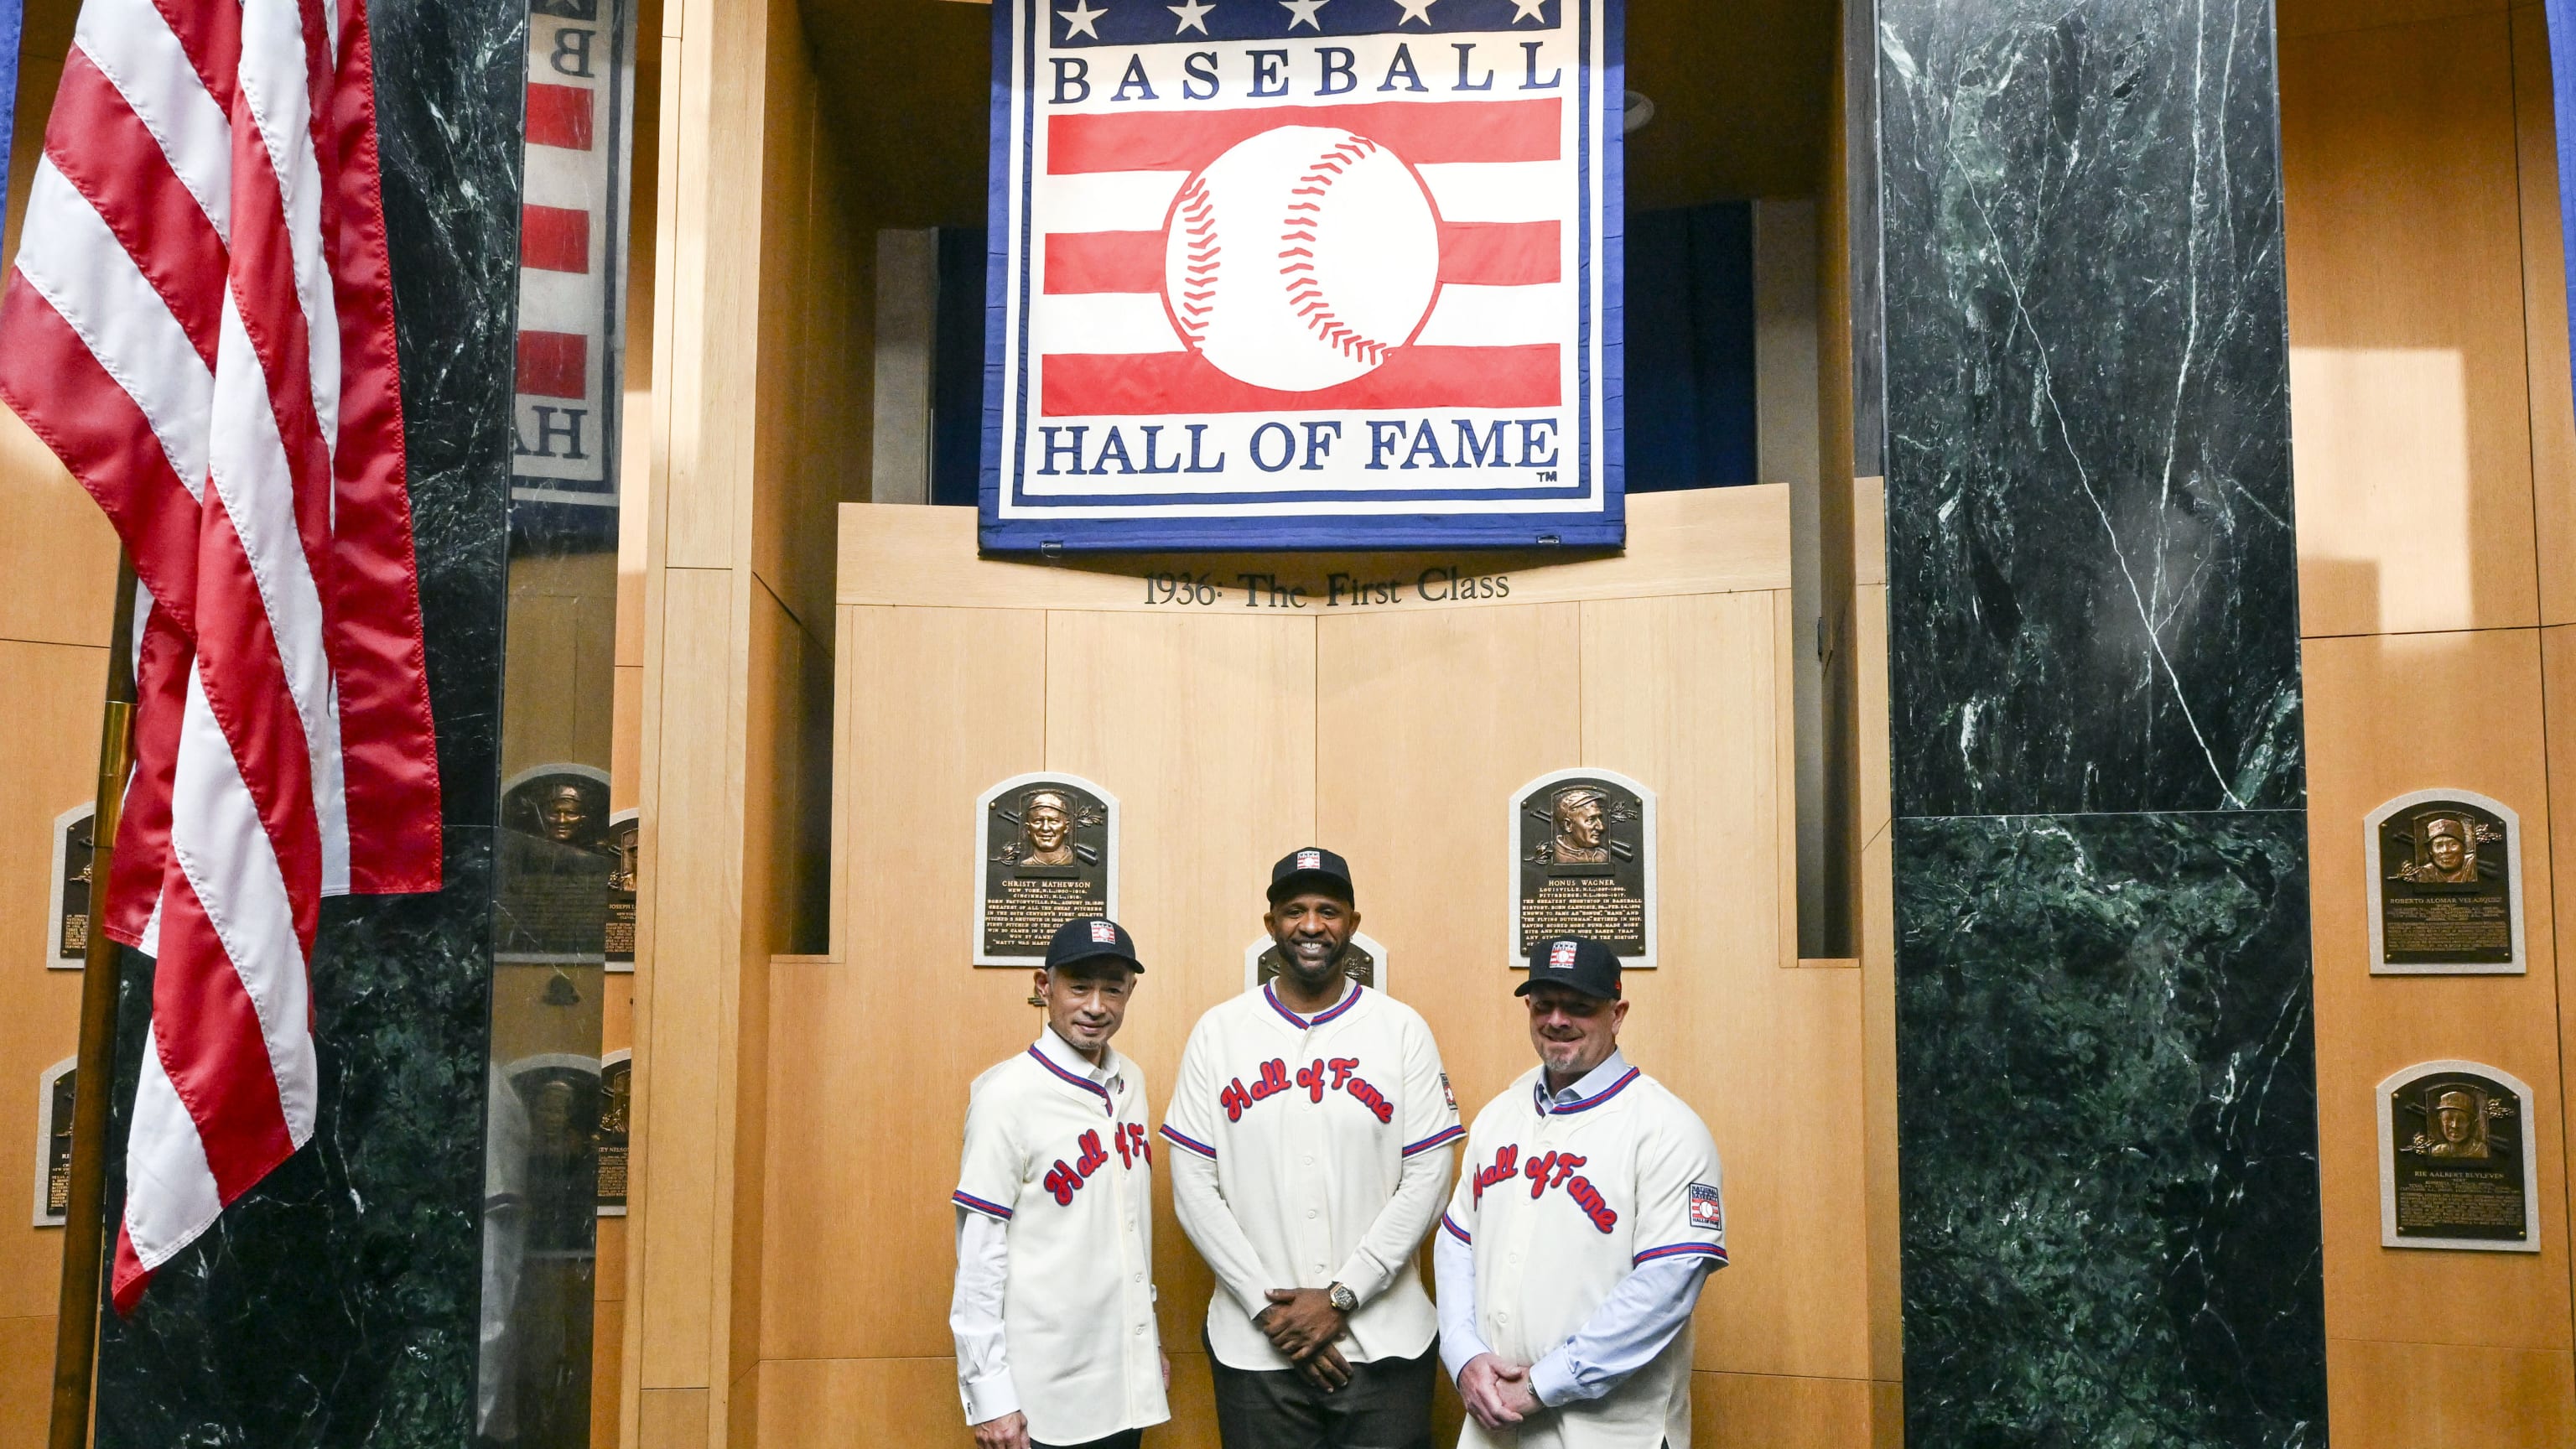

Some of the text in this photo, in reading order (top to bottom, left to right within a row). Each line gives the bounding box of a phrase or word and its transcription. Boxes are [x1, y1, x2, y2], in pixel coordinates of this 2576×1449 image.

[1048, 42, 1561, 104] BASEBALL
[1037, 418, 1559, 475] HALL OF FAME
[1144, 566, 1509, 608] 1936: The First Class
[1220, 1057, 1394, 1124] Hall of Fame
[1043, 1129, 1109, 1207] Hall
[1524, 1150, 1558, 1200] of
[1550, 1152, 1618, 1234] Fame
